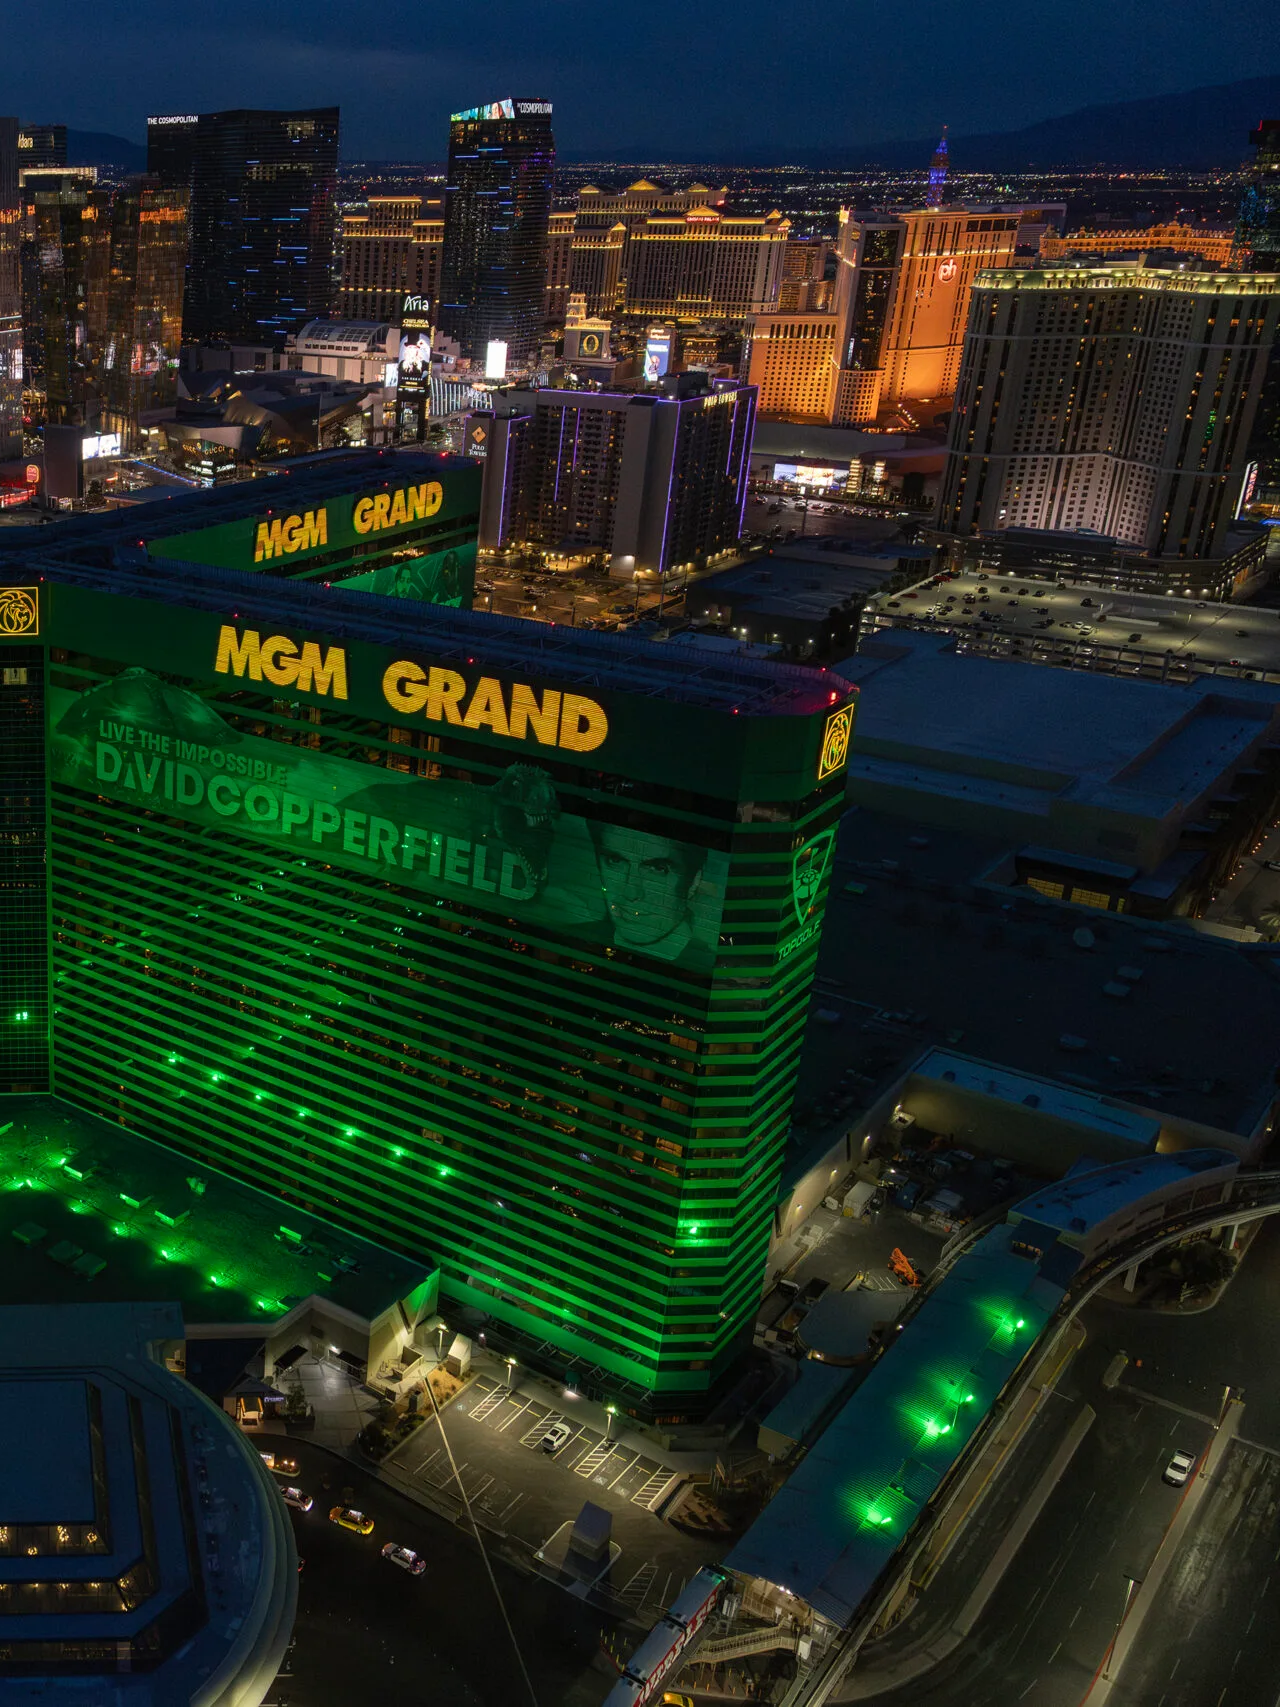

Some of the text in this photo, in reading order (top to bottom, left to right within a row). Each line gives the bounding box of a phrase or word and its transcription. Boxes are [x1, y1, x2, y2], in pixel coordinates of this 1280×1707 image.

[521, 103, 553, 114] COSMOPOLITAN
[147, 115, 198, 125] THE COSMOPOLITAN
[403, 296, 429, 312] Aria
[204, 446, 225, 455] GUCCI
[469, 443, 487, 457] POLO TOWERS
[254, 481, 443, 563] MGM GRAND
[215, 624, 608, 753] MGM GRAND
[99, 719, 288, 785] LIVE THE IMPOSSIBLE
[778, 919, 821, 961] TOPGOLF
